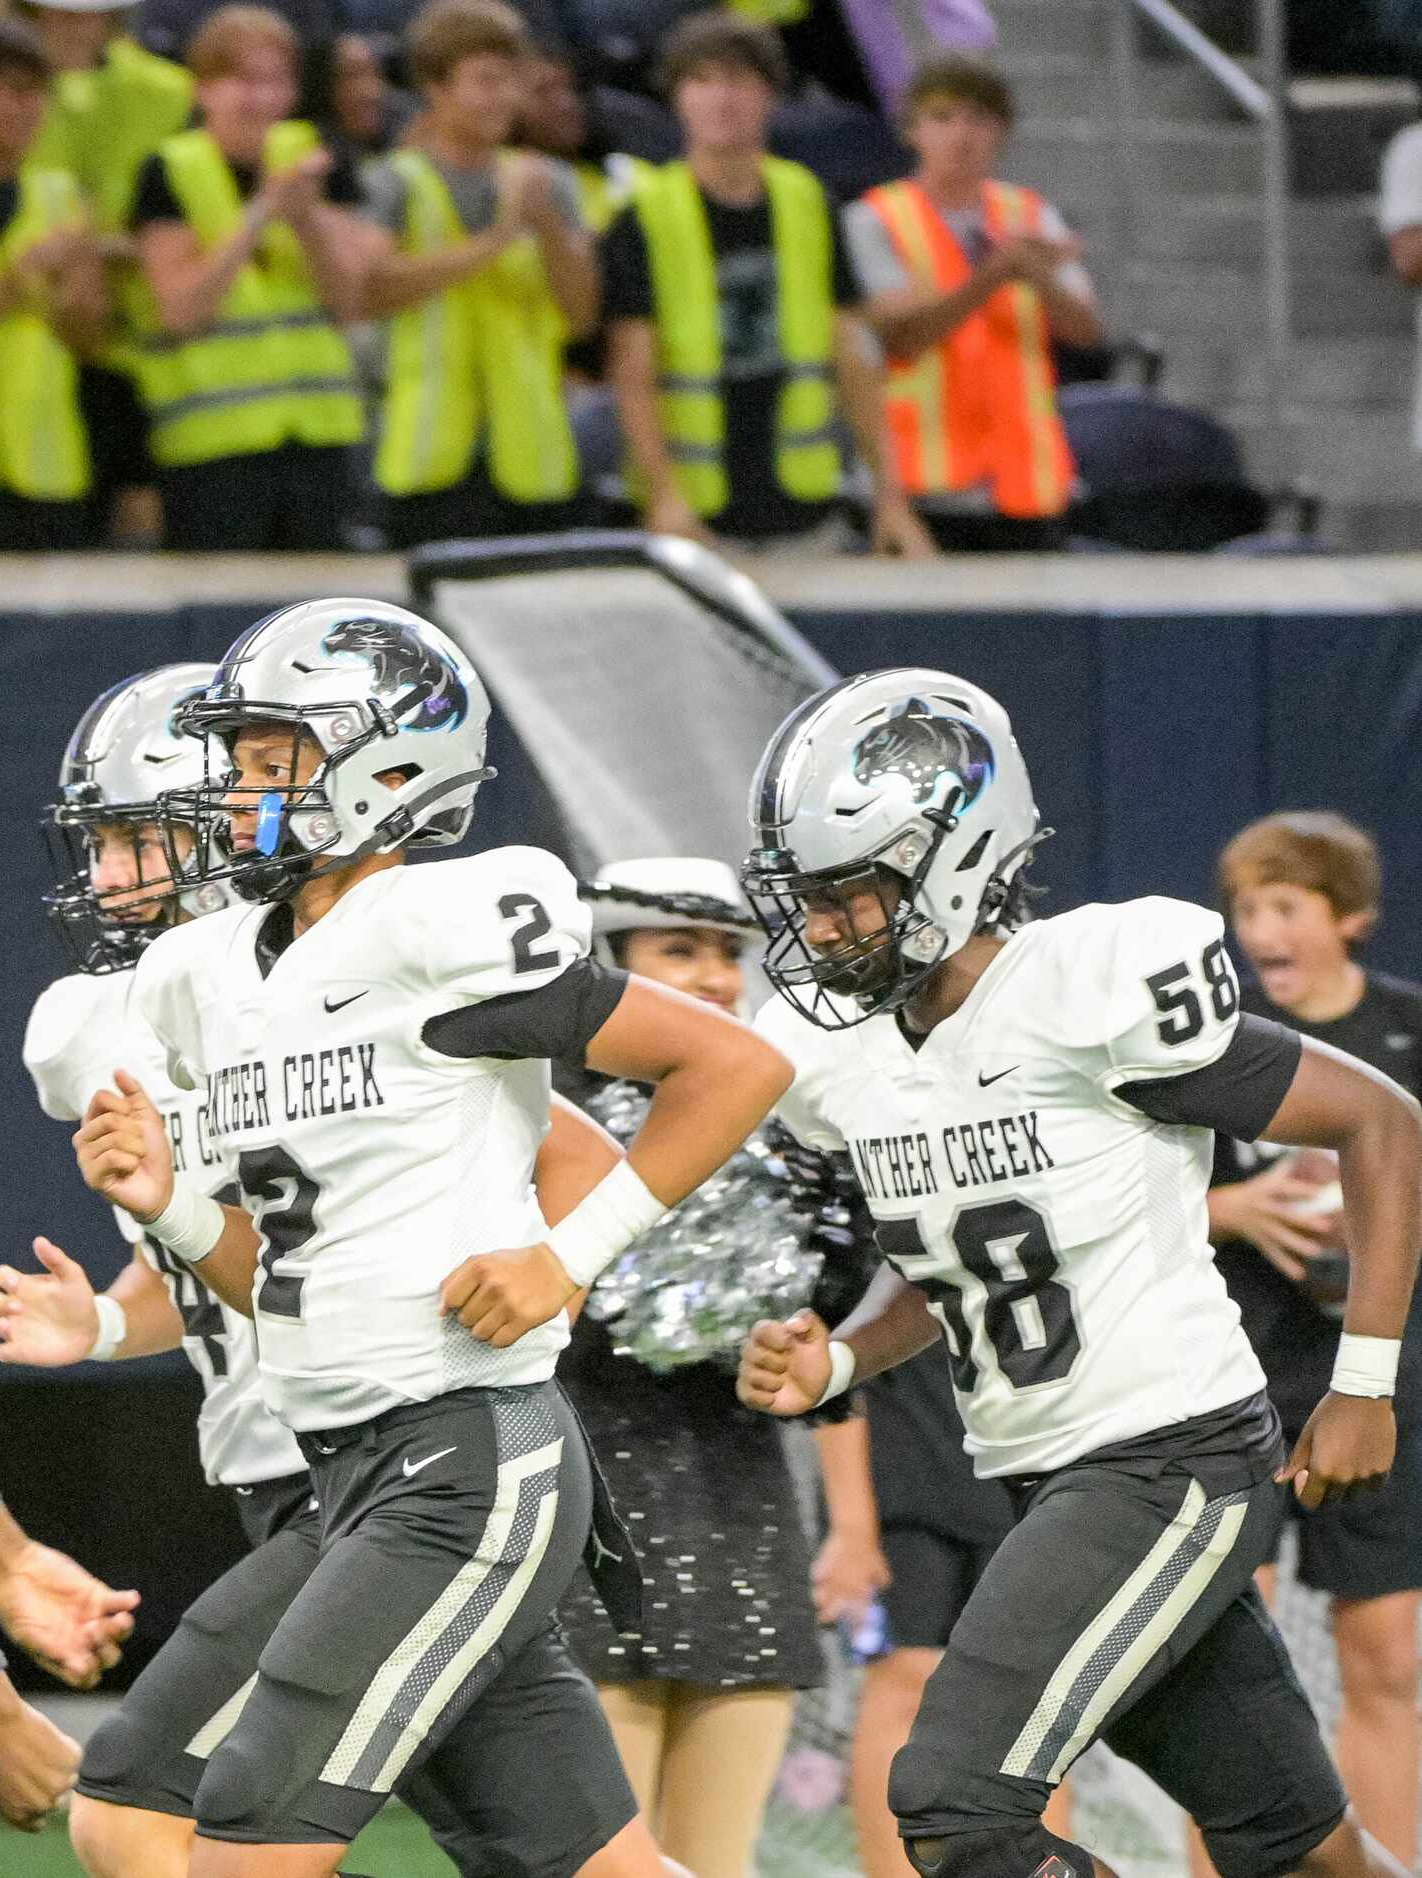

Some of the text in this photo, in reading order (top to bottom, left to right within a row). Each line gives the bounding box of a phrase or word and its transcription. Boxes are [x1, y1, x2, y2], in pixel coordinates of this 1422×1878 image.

[497, 893, 561, 975] 2
[1144, 938, 1237, 1047] 58
[283, 1043, 384, 1121] CREEK
[943, 1111, 1055, 1188] CREEK
[238, 1144, 321, 1319] 2
